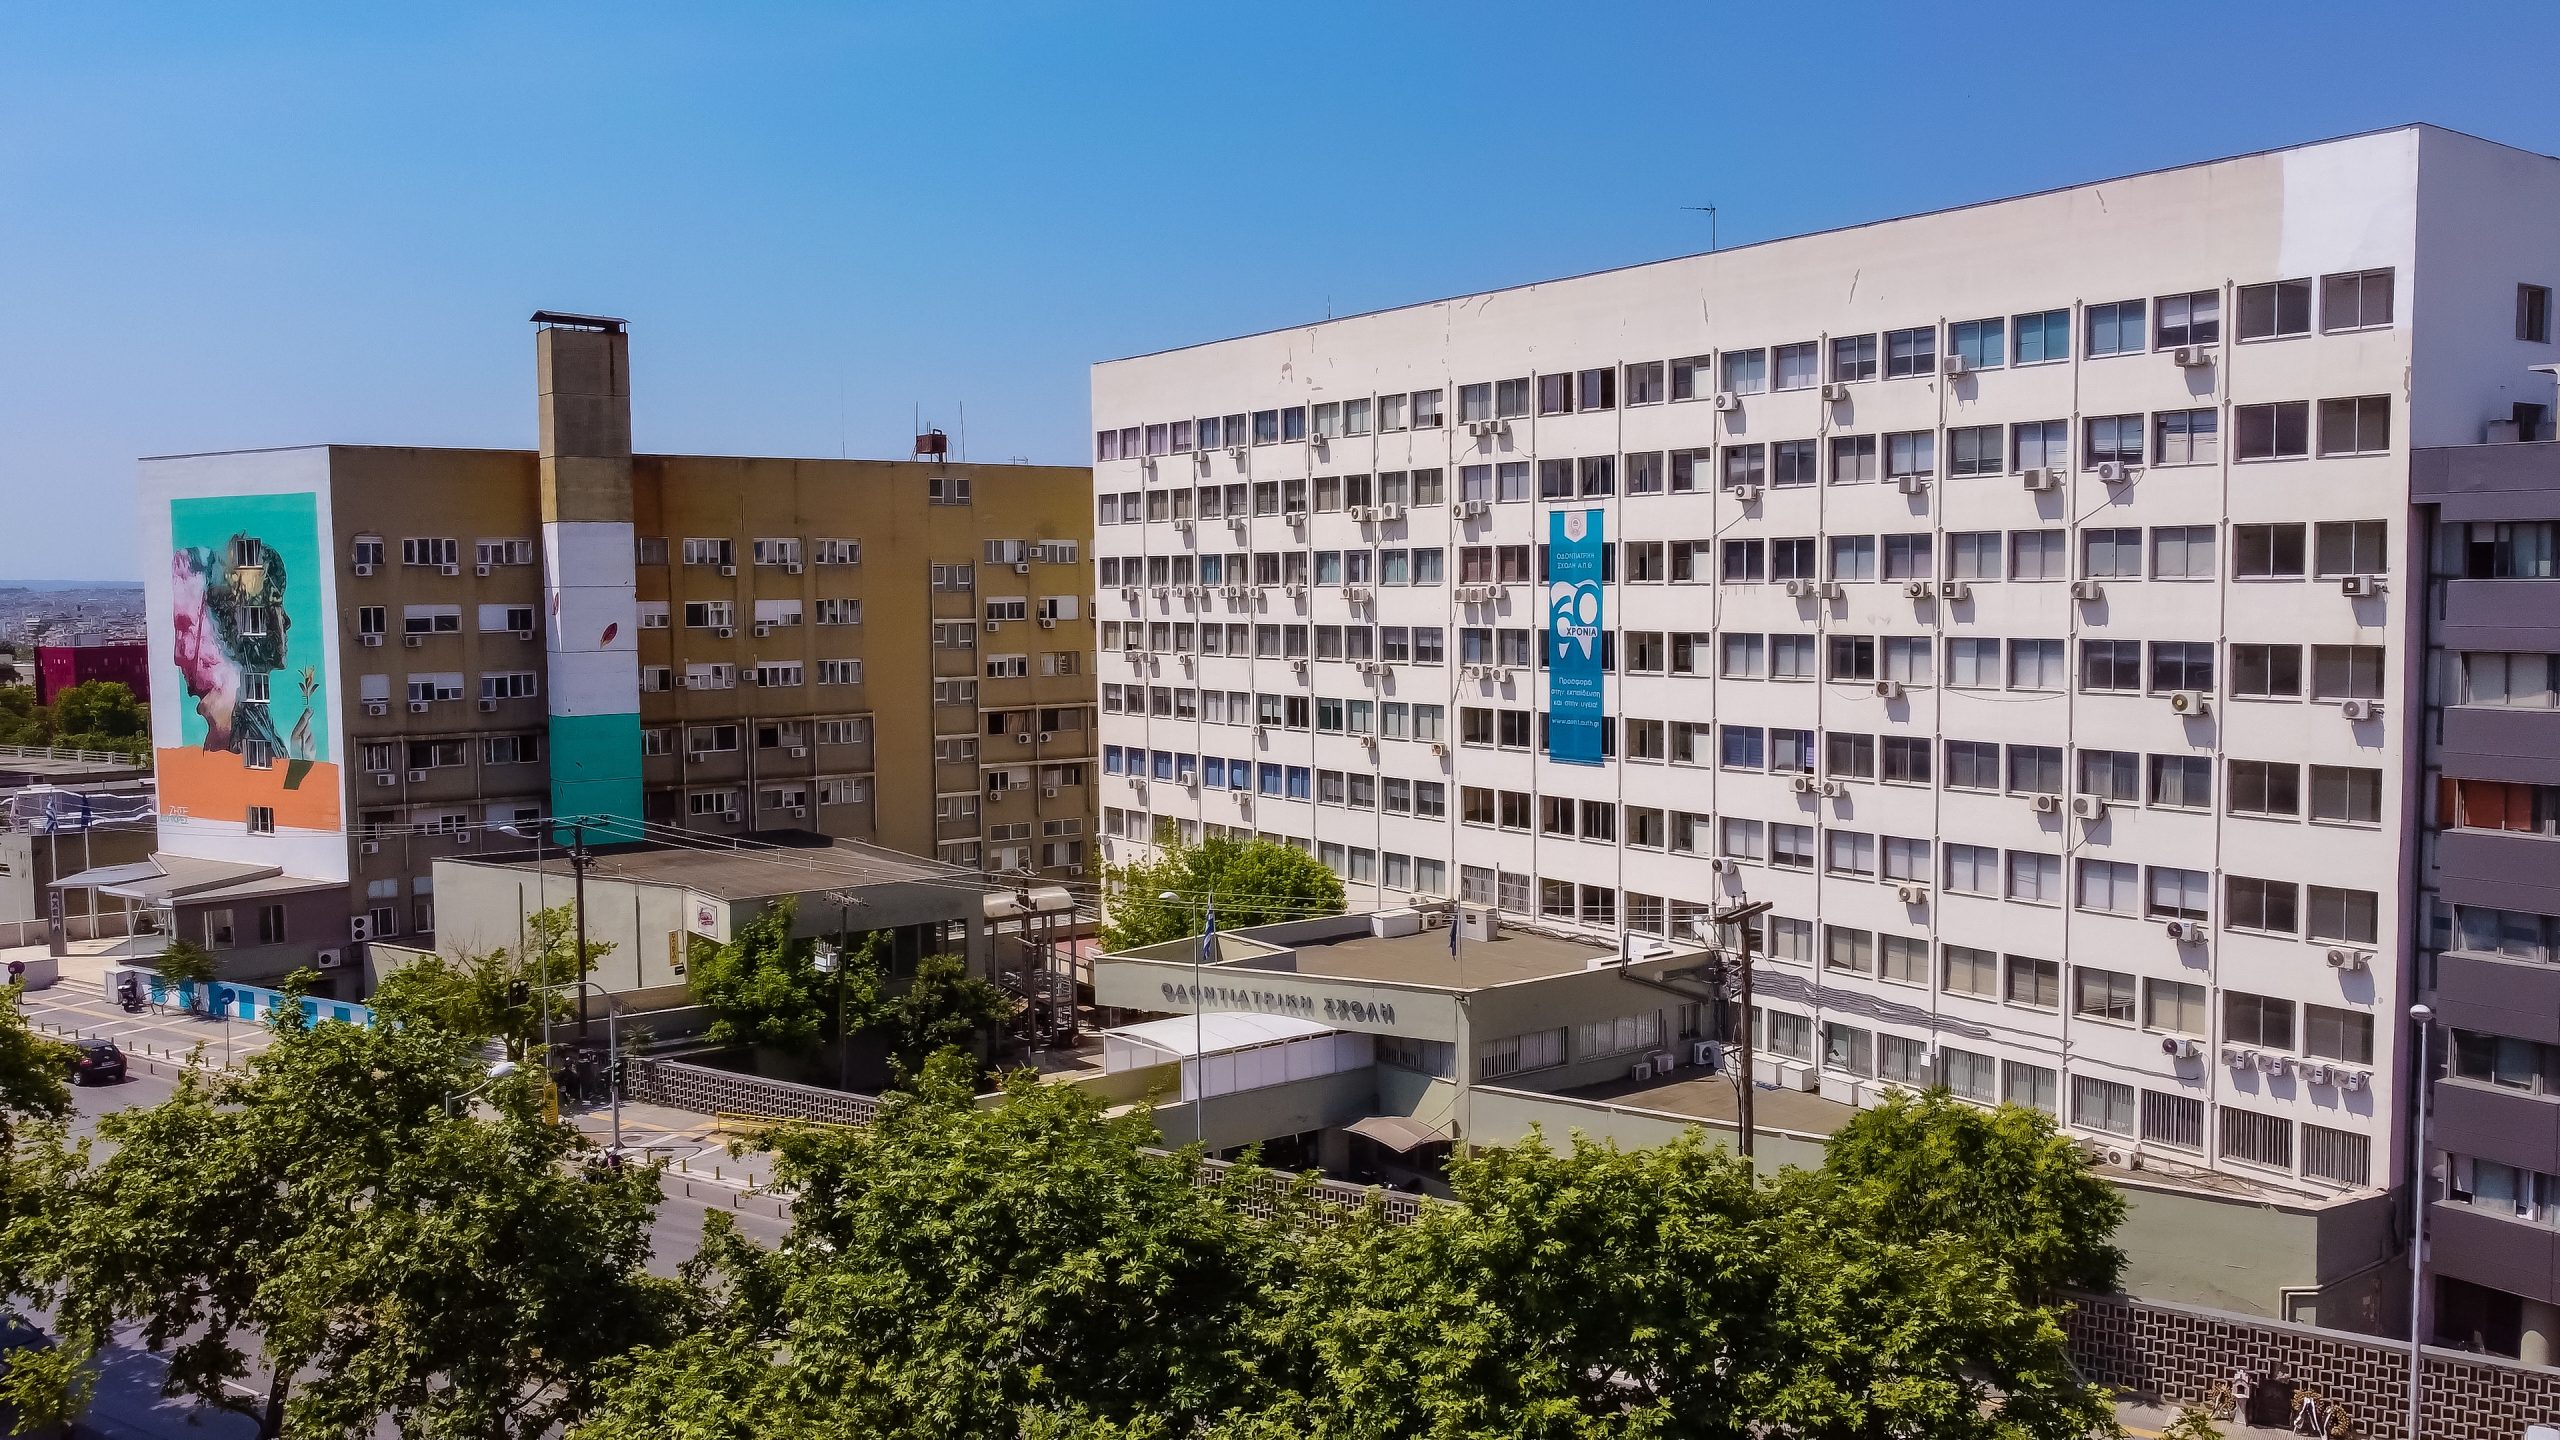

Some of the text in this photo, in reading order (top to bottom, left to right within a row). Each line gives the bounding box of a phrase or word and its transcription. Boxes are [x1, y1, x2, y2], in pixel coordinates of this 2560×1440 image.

[1566, 627, 1597, 636] ΧΡΟΝΙΑ
[51, 892, 61, 934] ΑΧΕΠΑ
[1161, 982, 1395, 1021] ΟΔΟΝΤΙΑΤΡΙΚΗ ΣΧΟΛΗ
